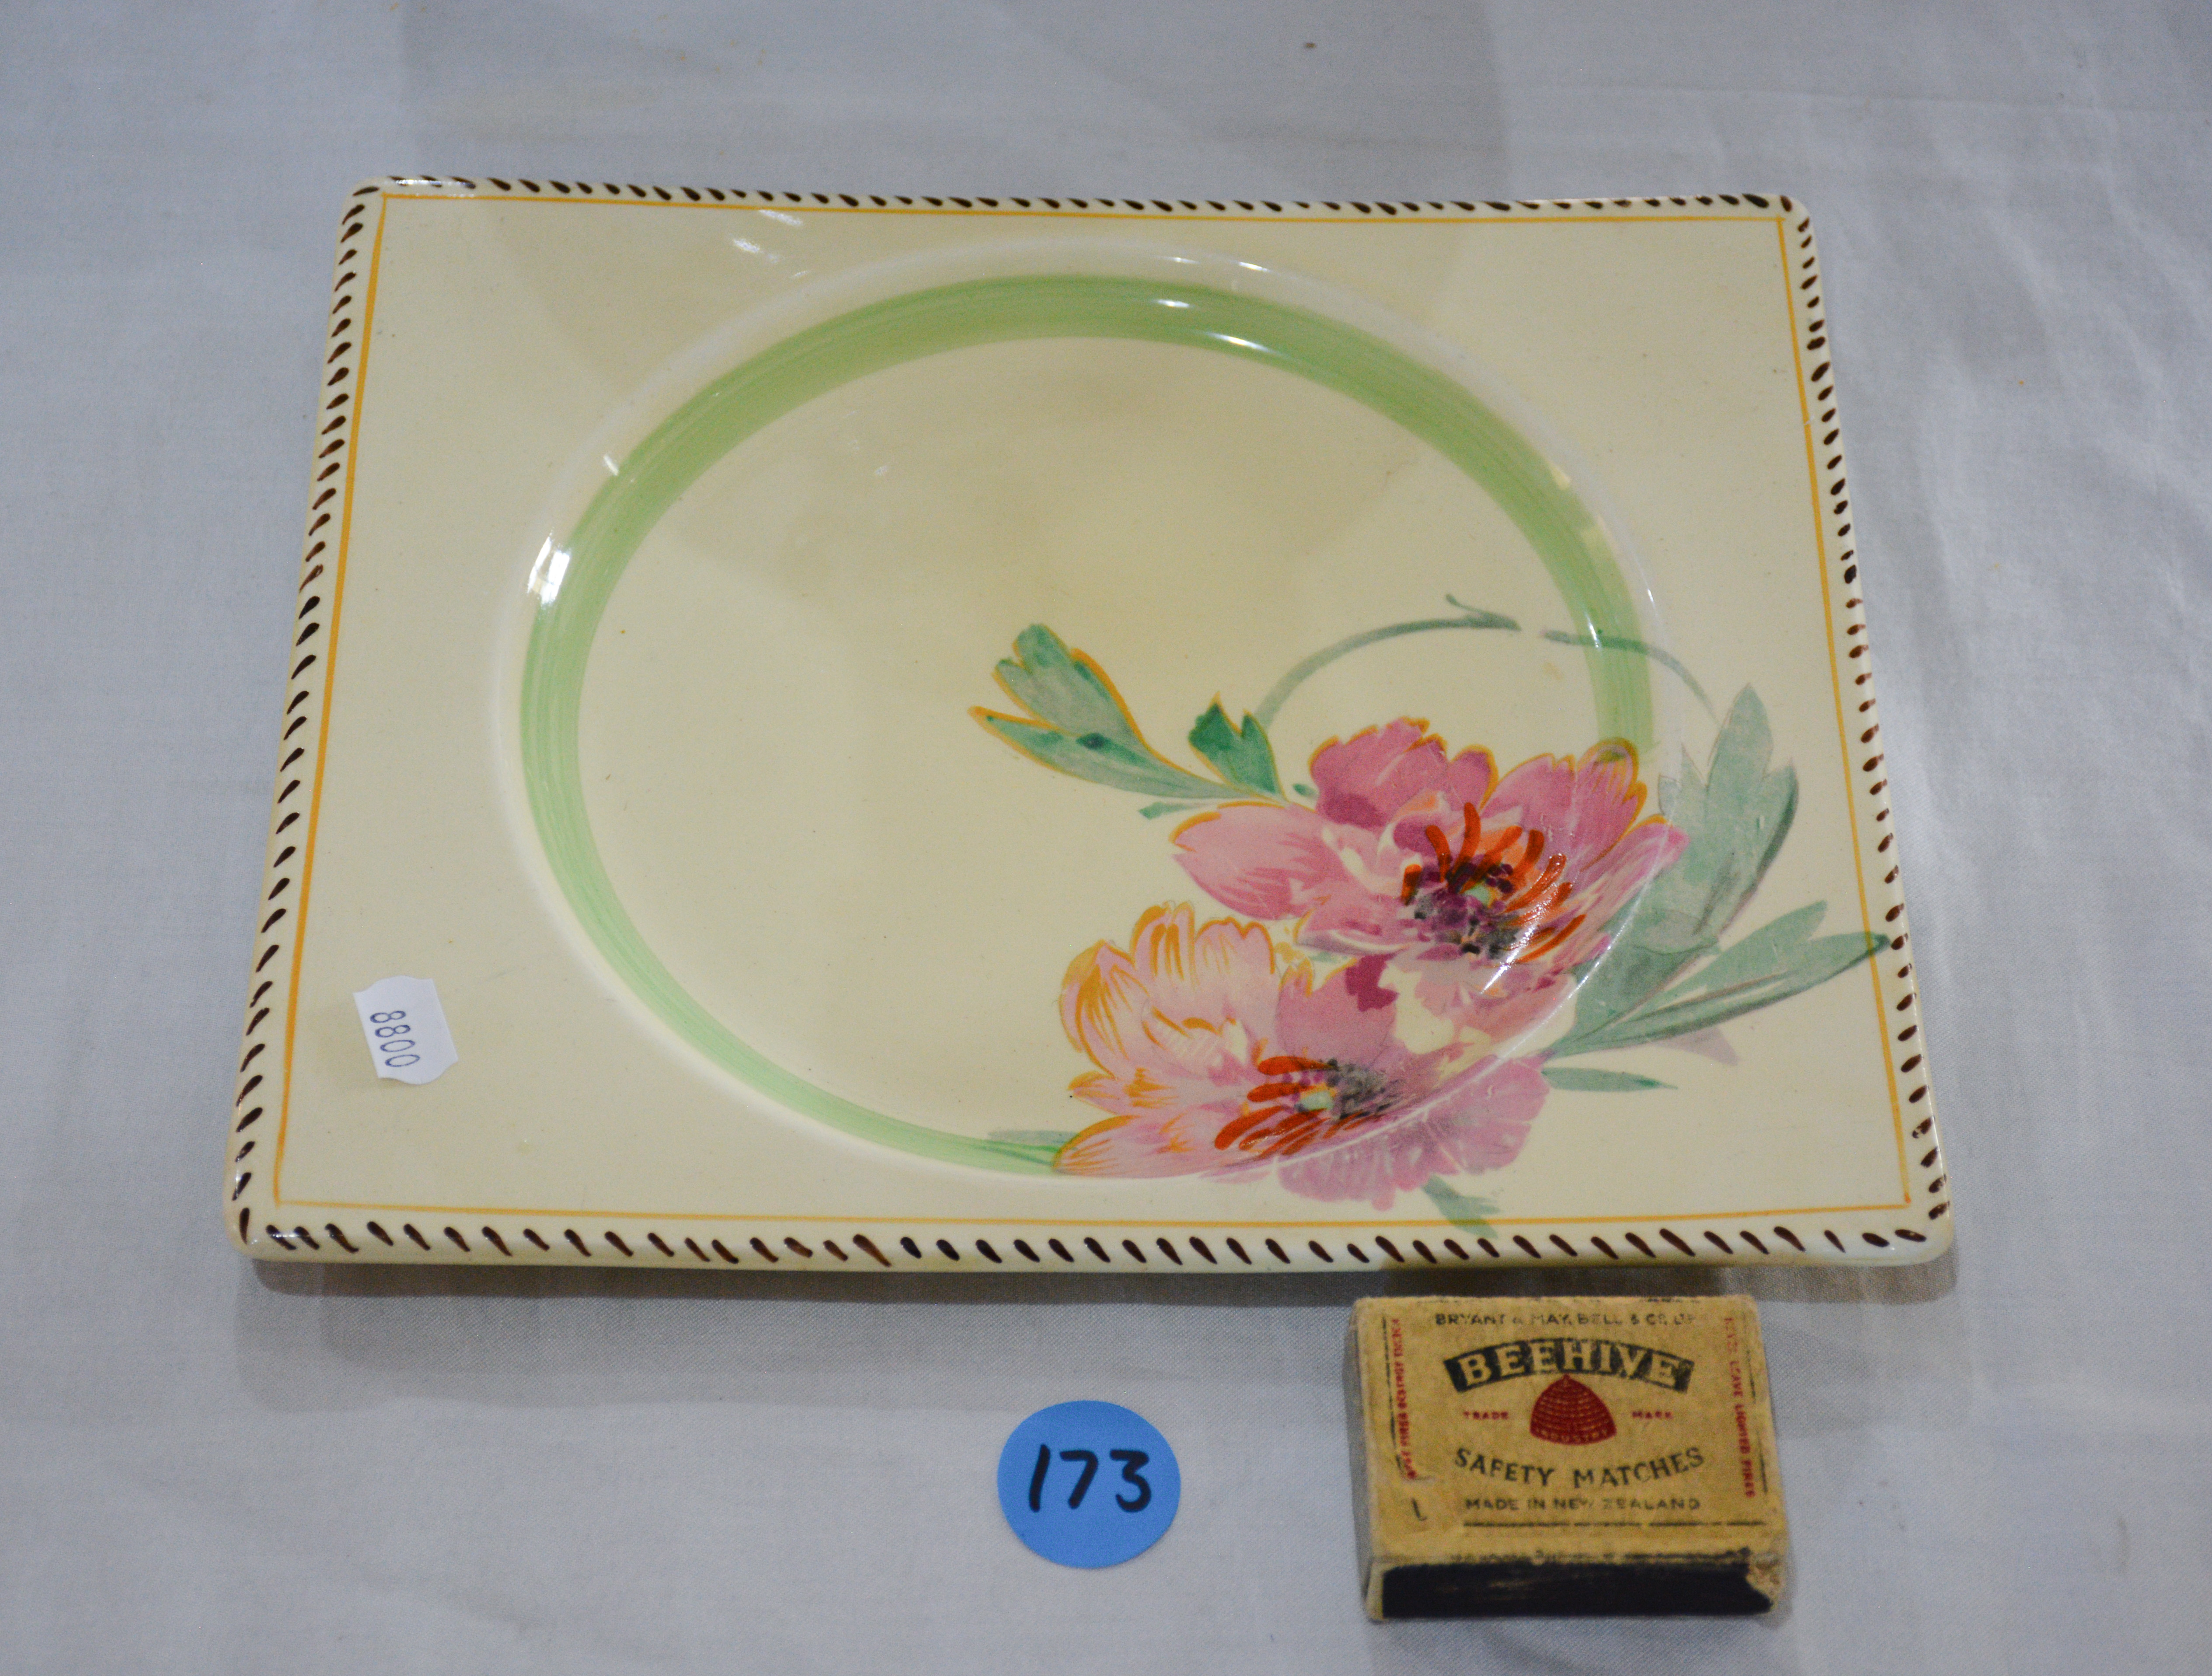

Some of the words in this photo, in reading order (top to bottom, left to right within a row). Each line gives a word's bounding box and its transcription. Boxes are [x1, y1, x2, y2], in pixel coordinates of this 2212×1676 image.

[369, 1010, 420, 1067] 8800
[1435, 1313, 1505, 1325] BRYANT
[1458, 1340, 1680, 1387] BEEHIVE
[1463, 1411, 1508, 1420] TRADE
[1632, 1411, 1673, 1419] MARK
[1028, 1444, 1152, 1513] 173
[1454, 1447, 1554, 1486] SAFETY
[1574, 1446, 1704, 1488] MATCHES
[1465, 1497, 1519, 1511] MADE
[1528, 1498, 1546, 1510] IN
[1554, 1498, 1594, 1511] NEW
[1602, 1497, 1701, 1511] ZEALAND
